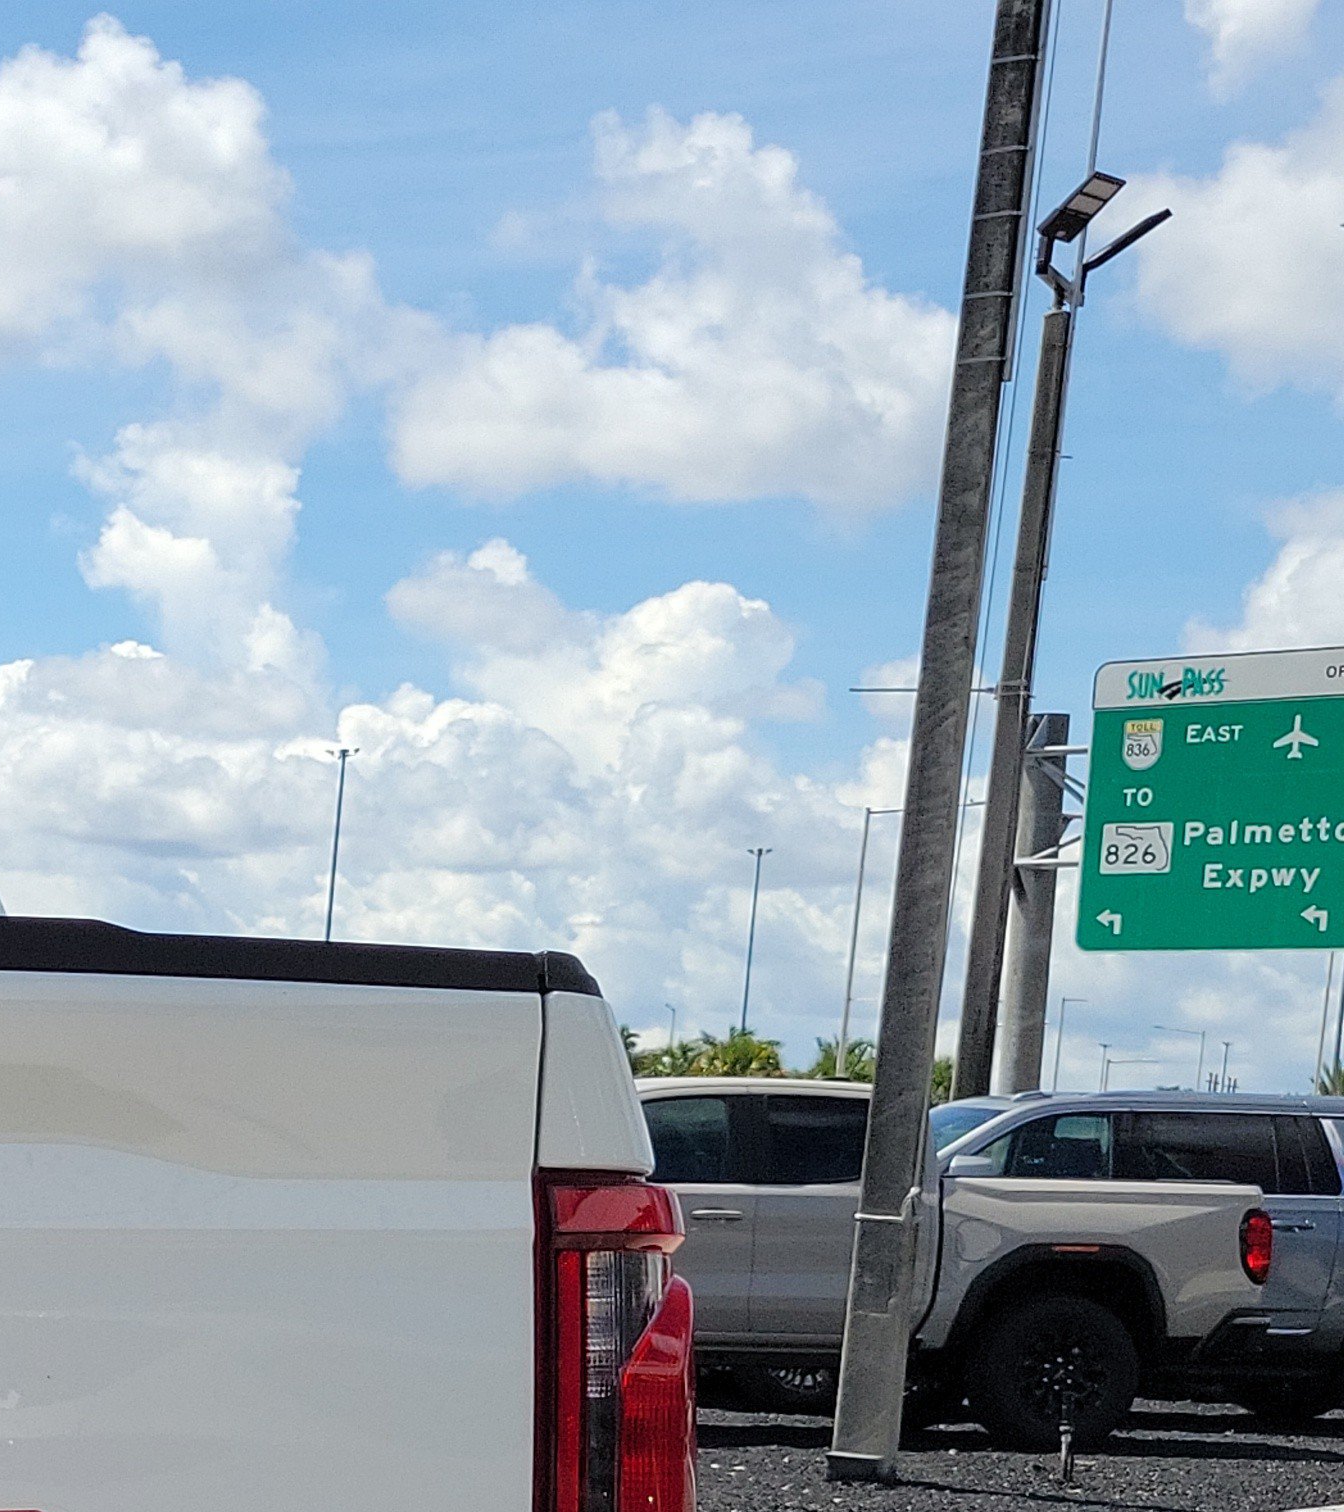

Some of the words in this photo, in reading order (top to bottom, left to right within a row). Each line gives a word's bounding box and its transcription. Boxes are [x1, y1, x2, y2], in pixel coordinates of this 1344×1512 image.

[1131, 723, 1158, 733] TOLL
[1186, 724, 1244, 743] EAST
[1126, 742, 1150, 758] 836
[1123, 787, 1153, 806] TO
[1105, 843, 1156, 866] 826
[1202, 862, 1321, 894] Expwy
